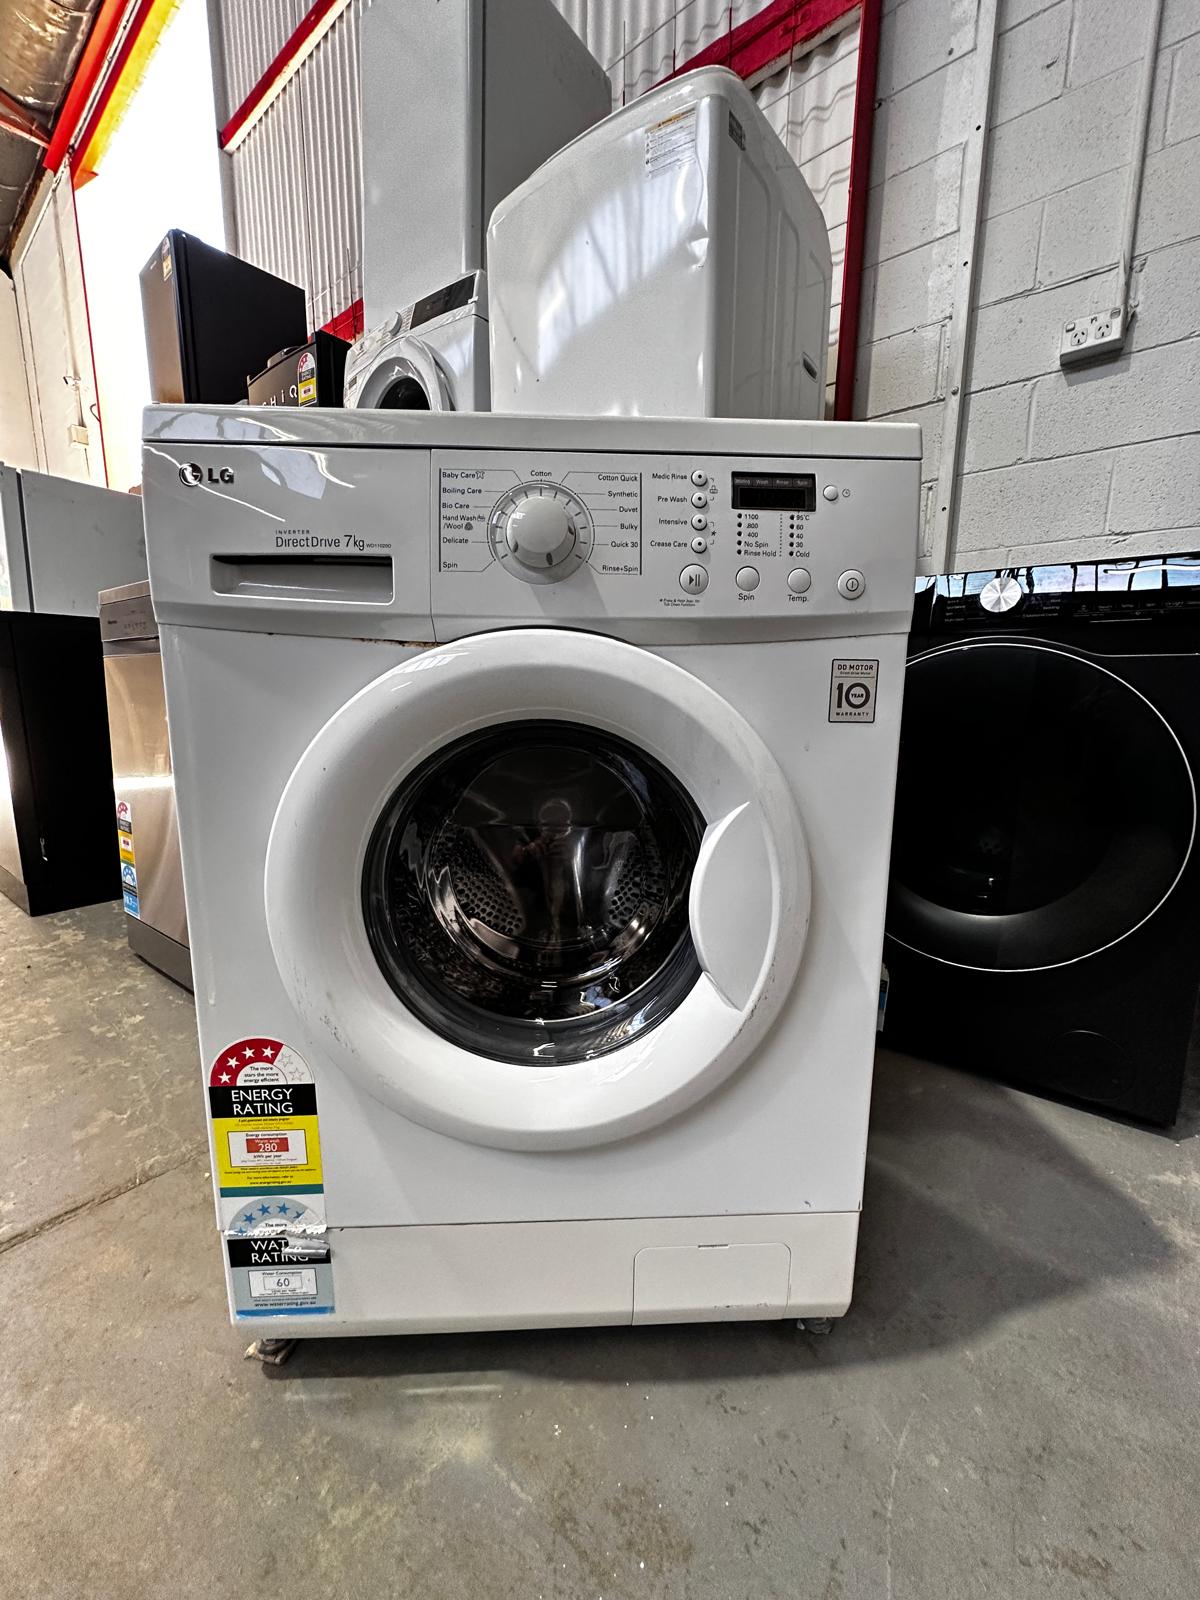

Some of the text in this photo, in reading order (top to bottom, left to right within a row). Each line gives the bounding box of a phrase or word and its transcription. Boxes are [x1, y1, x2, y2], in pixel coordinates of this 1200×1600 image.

[208, 467, 234, 484] LG
[738, 593, 755, 601] Spin
[788, 594, 808, 603] Temp.
[836, 682, 870, 709] 10
[231, 1088, 293, 1101] ENERGY
[233, 1103, 293, 1115] RATING
[258, 1143, 277, 1152] 280
[276, 1278, 290, 1287] 60
